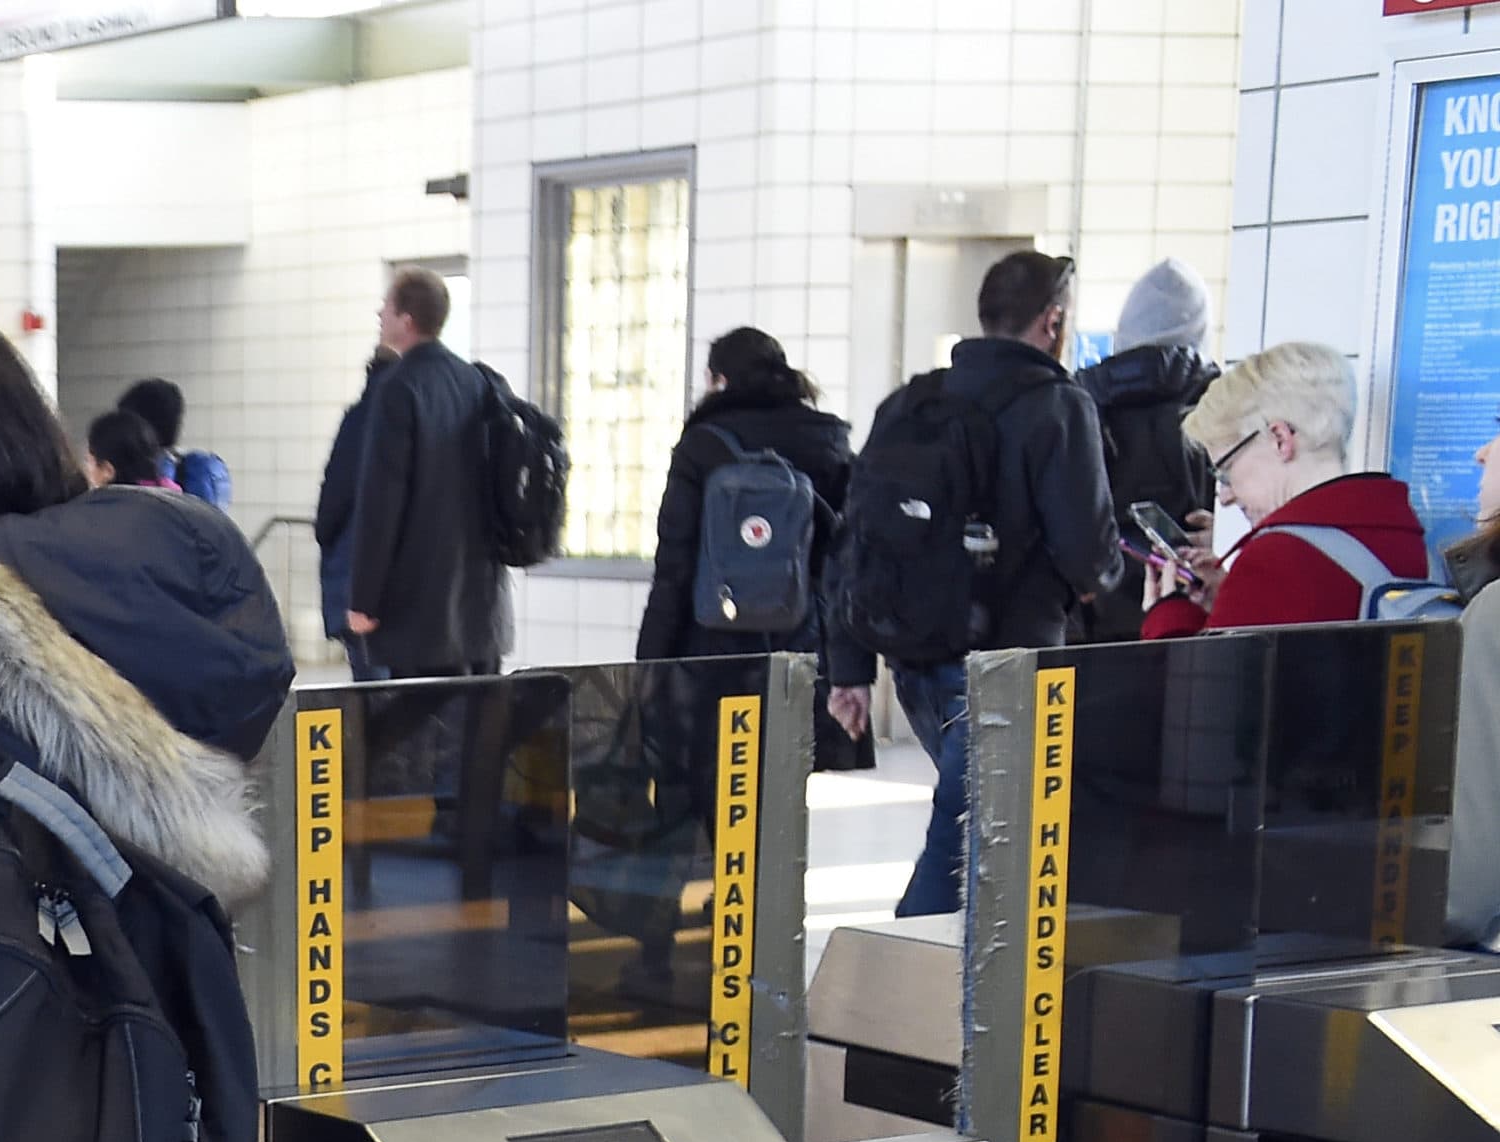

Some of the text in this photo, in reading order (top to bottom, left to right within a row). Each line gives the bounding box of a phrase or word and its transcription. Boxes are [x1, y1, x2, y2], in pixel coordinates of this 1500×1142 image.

[309, 724, 333, 853] KEEP
[729, 709, 751, 828] KEEP
[308, 880, 331, 1038] HANDS
[722, 852, 746, 998] HANDS
[1029, 682, 1067, 1135] KEEP HANDS CLEAR
